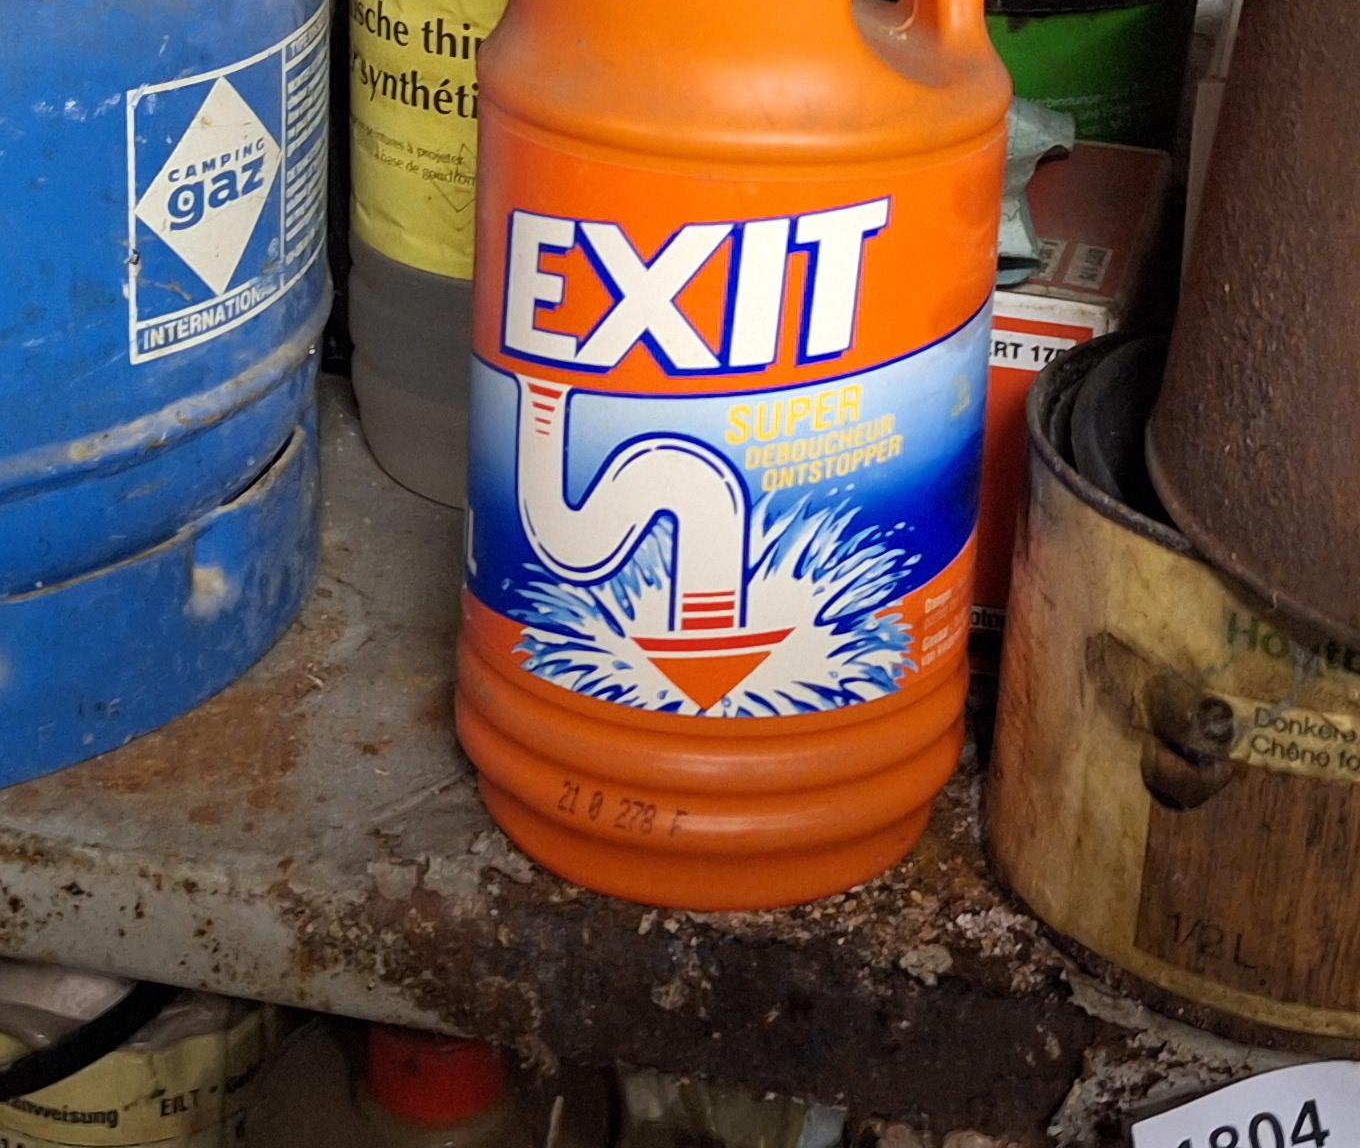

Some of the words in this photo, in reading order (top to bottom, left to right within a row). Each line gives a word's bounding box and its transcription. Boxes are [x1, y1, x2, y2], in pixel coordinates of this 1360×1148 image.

[167, 136, 265, 183] CAMPING
[167, 152, 267, 232] gaz
[501, 195, 892, 376] EXIT
[143, 282, 278, 351] INTERNATION
[988, 338, 1023, 360] RT
[724, 384, 865, 446] SUPER
[745, 412, 898, 471] DEBOUCHEUR
[761, 434, 905, 494] ONTSTOPPER
[1176, 1098, 1331, 1148] 804
